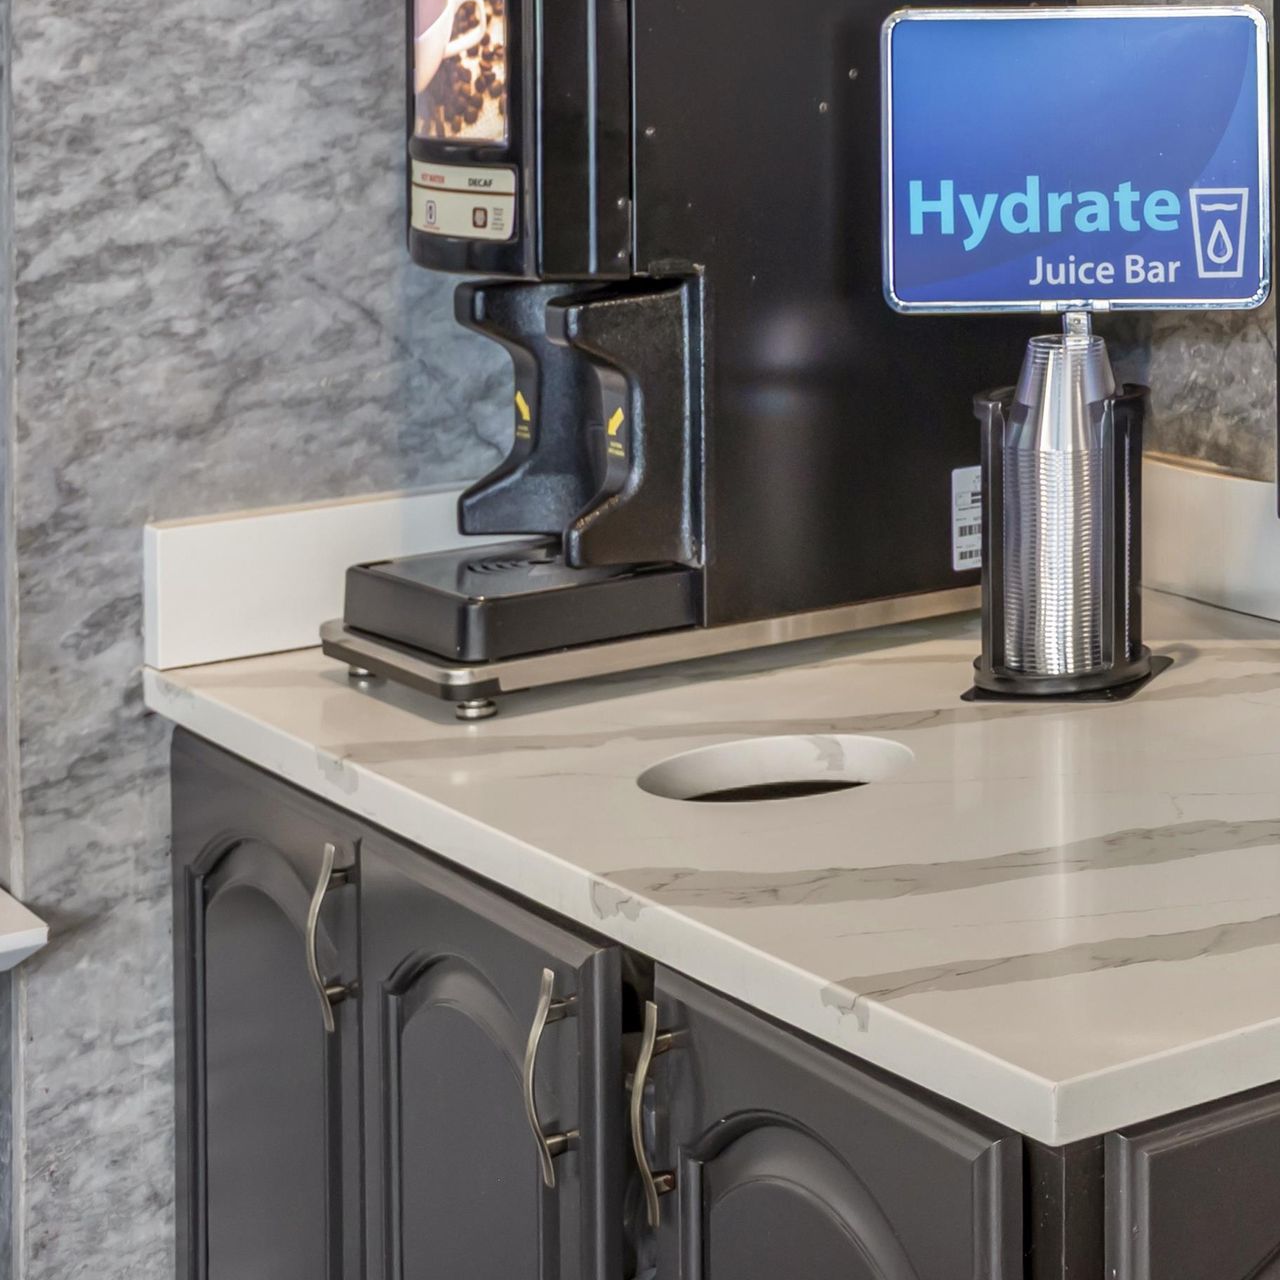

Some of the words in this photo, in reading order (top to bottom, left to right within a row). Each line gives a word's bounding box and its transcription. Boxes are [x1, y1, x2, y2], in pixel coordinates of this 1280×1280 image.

[468, 178, 493, 188] DECAF
[908, 175, 1182, 251] Hydrate
[1028, 254, 1115, 286] Juice
[1125, 254, 1181, 284] Bar
